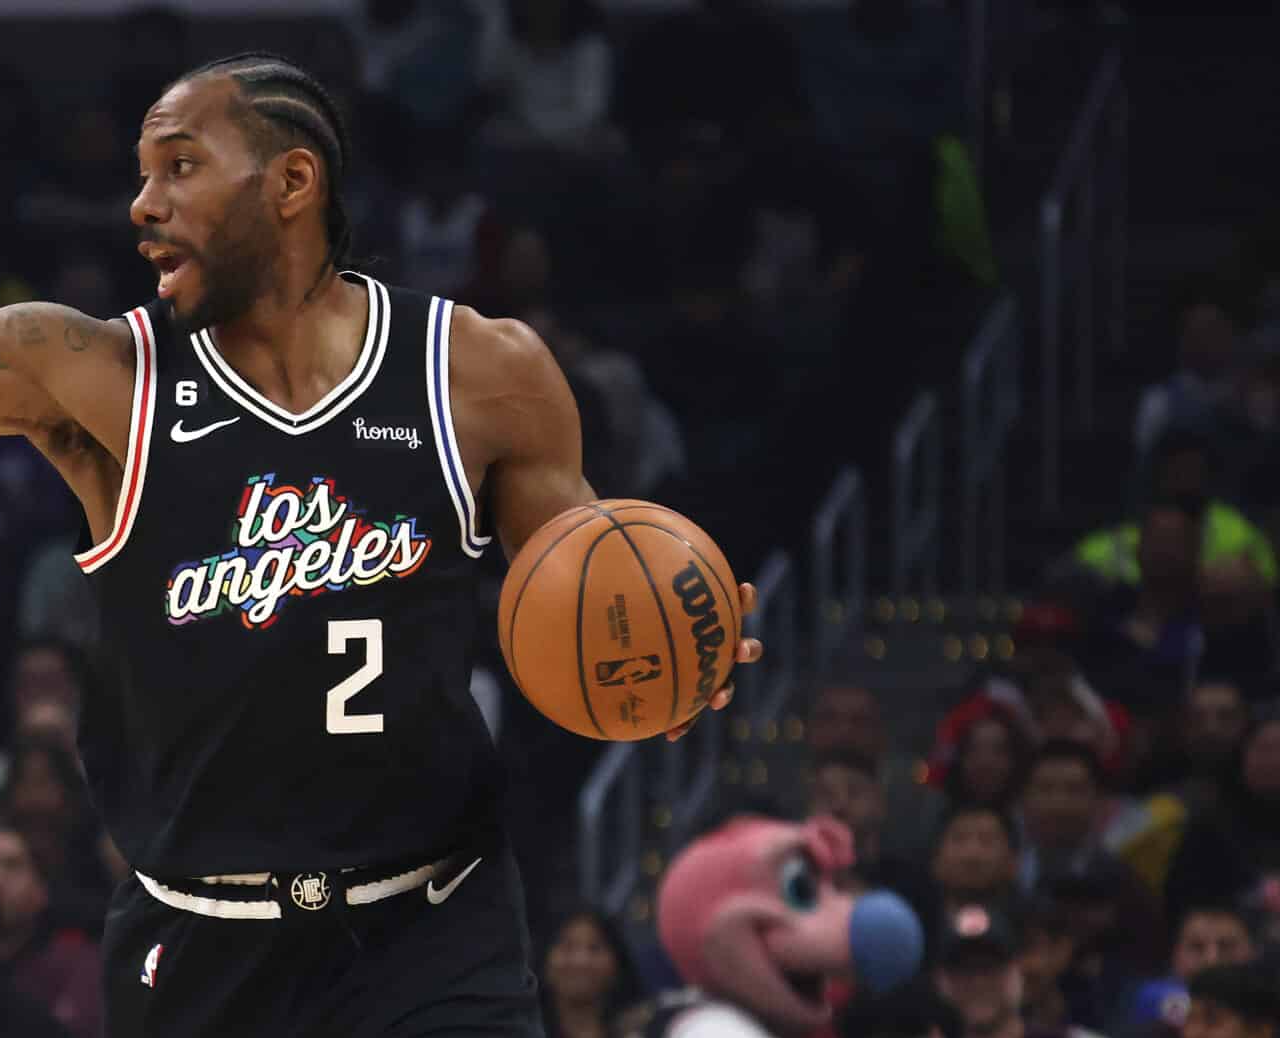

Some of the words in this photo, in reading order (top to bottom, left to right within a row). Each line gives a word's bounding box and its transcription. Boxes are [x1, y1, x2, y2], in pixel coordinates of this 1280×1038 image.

[174, 380, 198, 406] 6
[352, 417, 422, 448] honey
[237, 479, 347, 548] los
[168, 516, 427, 624] angeles
[325, 618, 385, 735] 2
